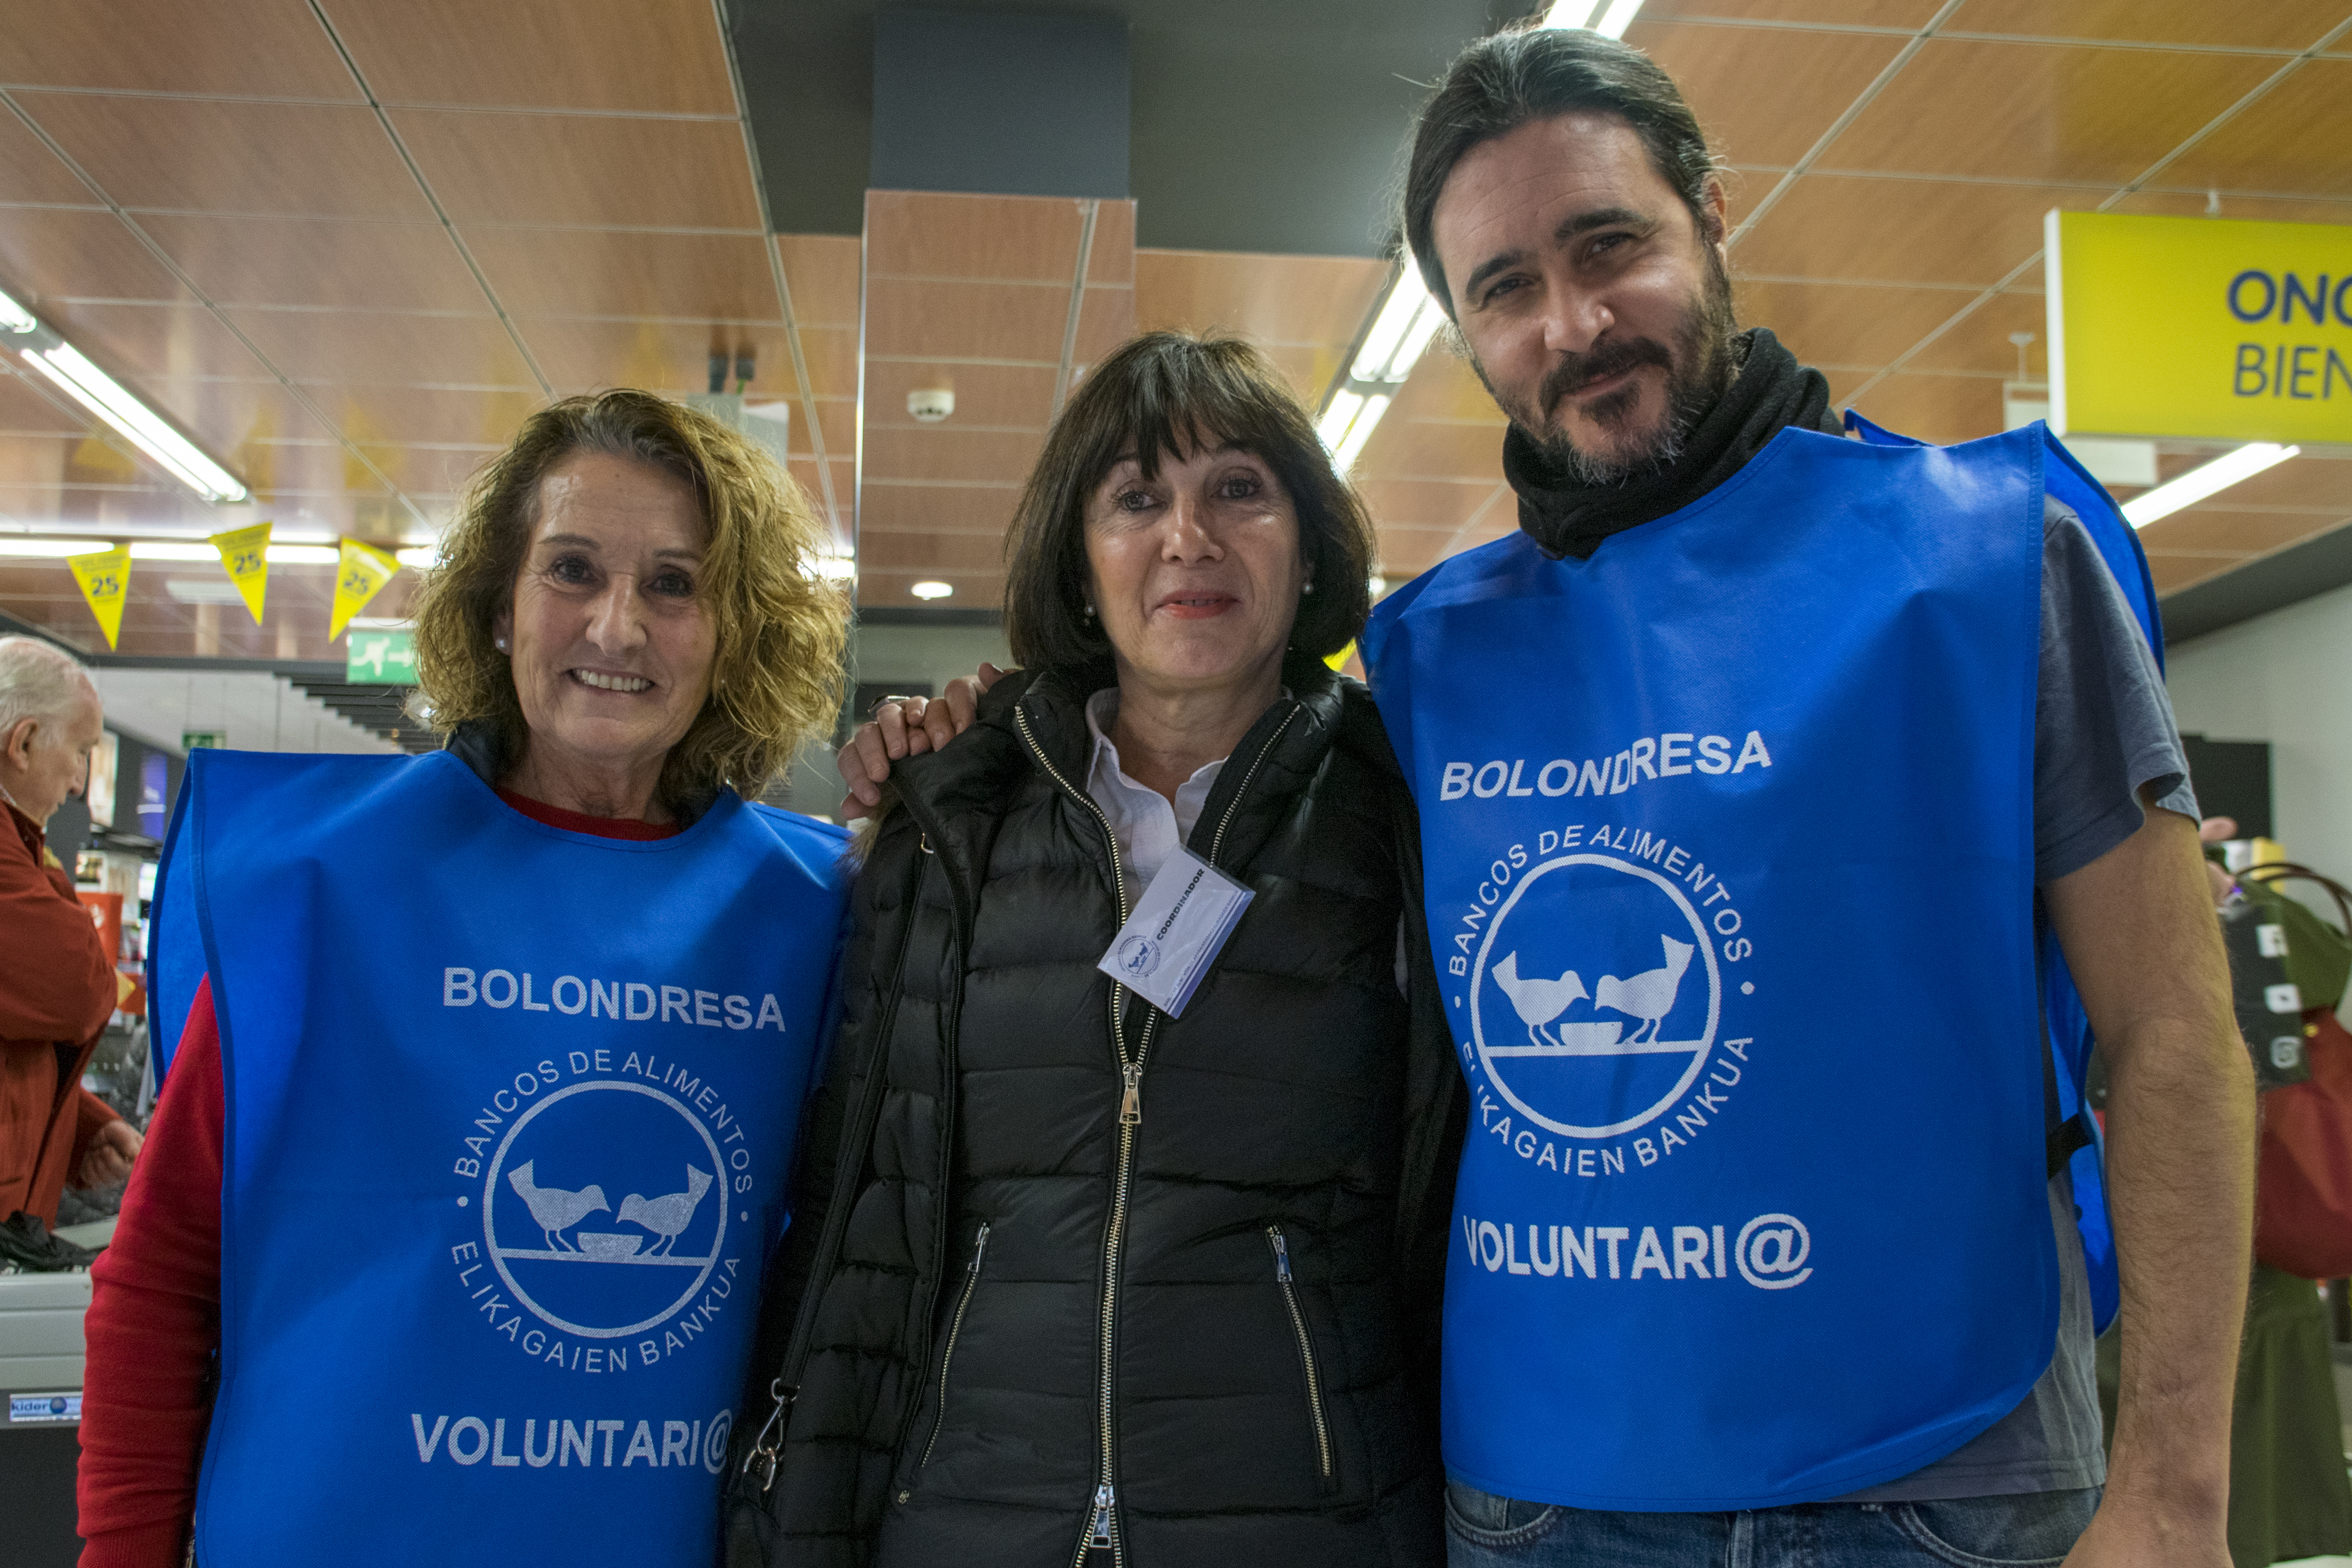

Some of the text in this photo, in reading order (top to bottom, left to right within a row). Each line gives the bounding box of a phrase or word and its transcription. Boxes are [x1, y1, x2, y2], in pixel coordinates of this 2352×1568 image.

[91, 576, 119, 597] 25
[233, 552, 261, 574] 25
[343, 572, 370, 595] 25
[1440, 730, 1772, 801] BOLONDRESA
[1155, 868, 1205, 941] COORDINADOR
[1449, 825, 1752, 977] BANCOS DE ALIMENTOS
[443, 967, 786, 1032] BOLONDRESA
[454, 1049, 752, 1194] BANCOS DE ALIMENTOS
[1463, 1037, 1753, 1177] EKAGAIEN BANKUA
[1463, 1213, 1813, 1290] VOLUNTARI@
[452, 1241, 740, 1373] ELIKAGAIEN BANKUA
[411, 1409, 733, 1474] VOLUNTARI@
